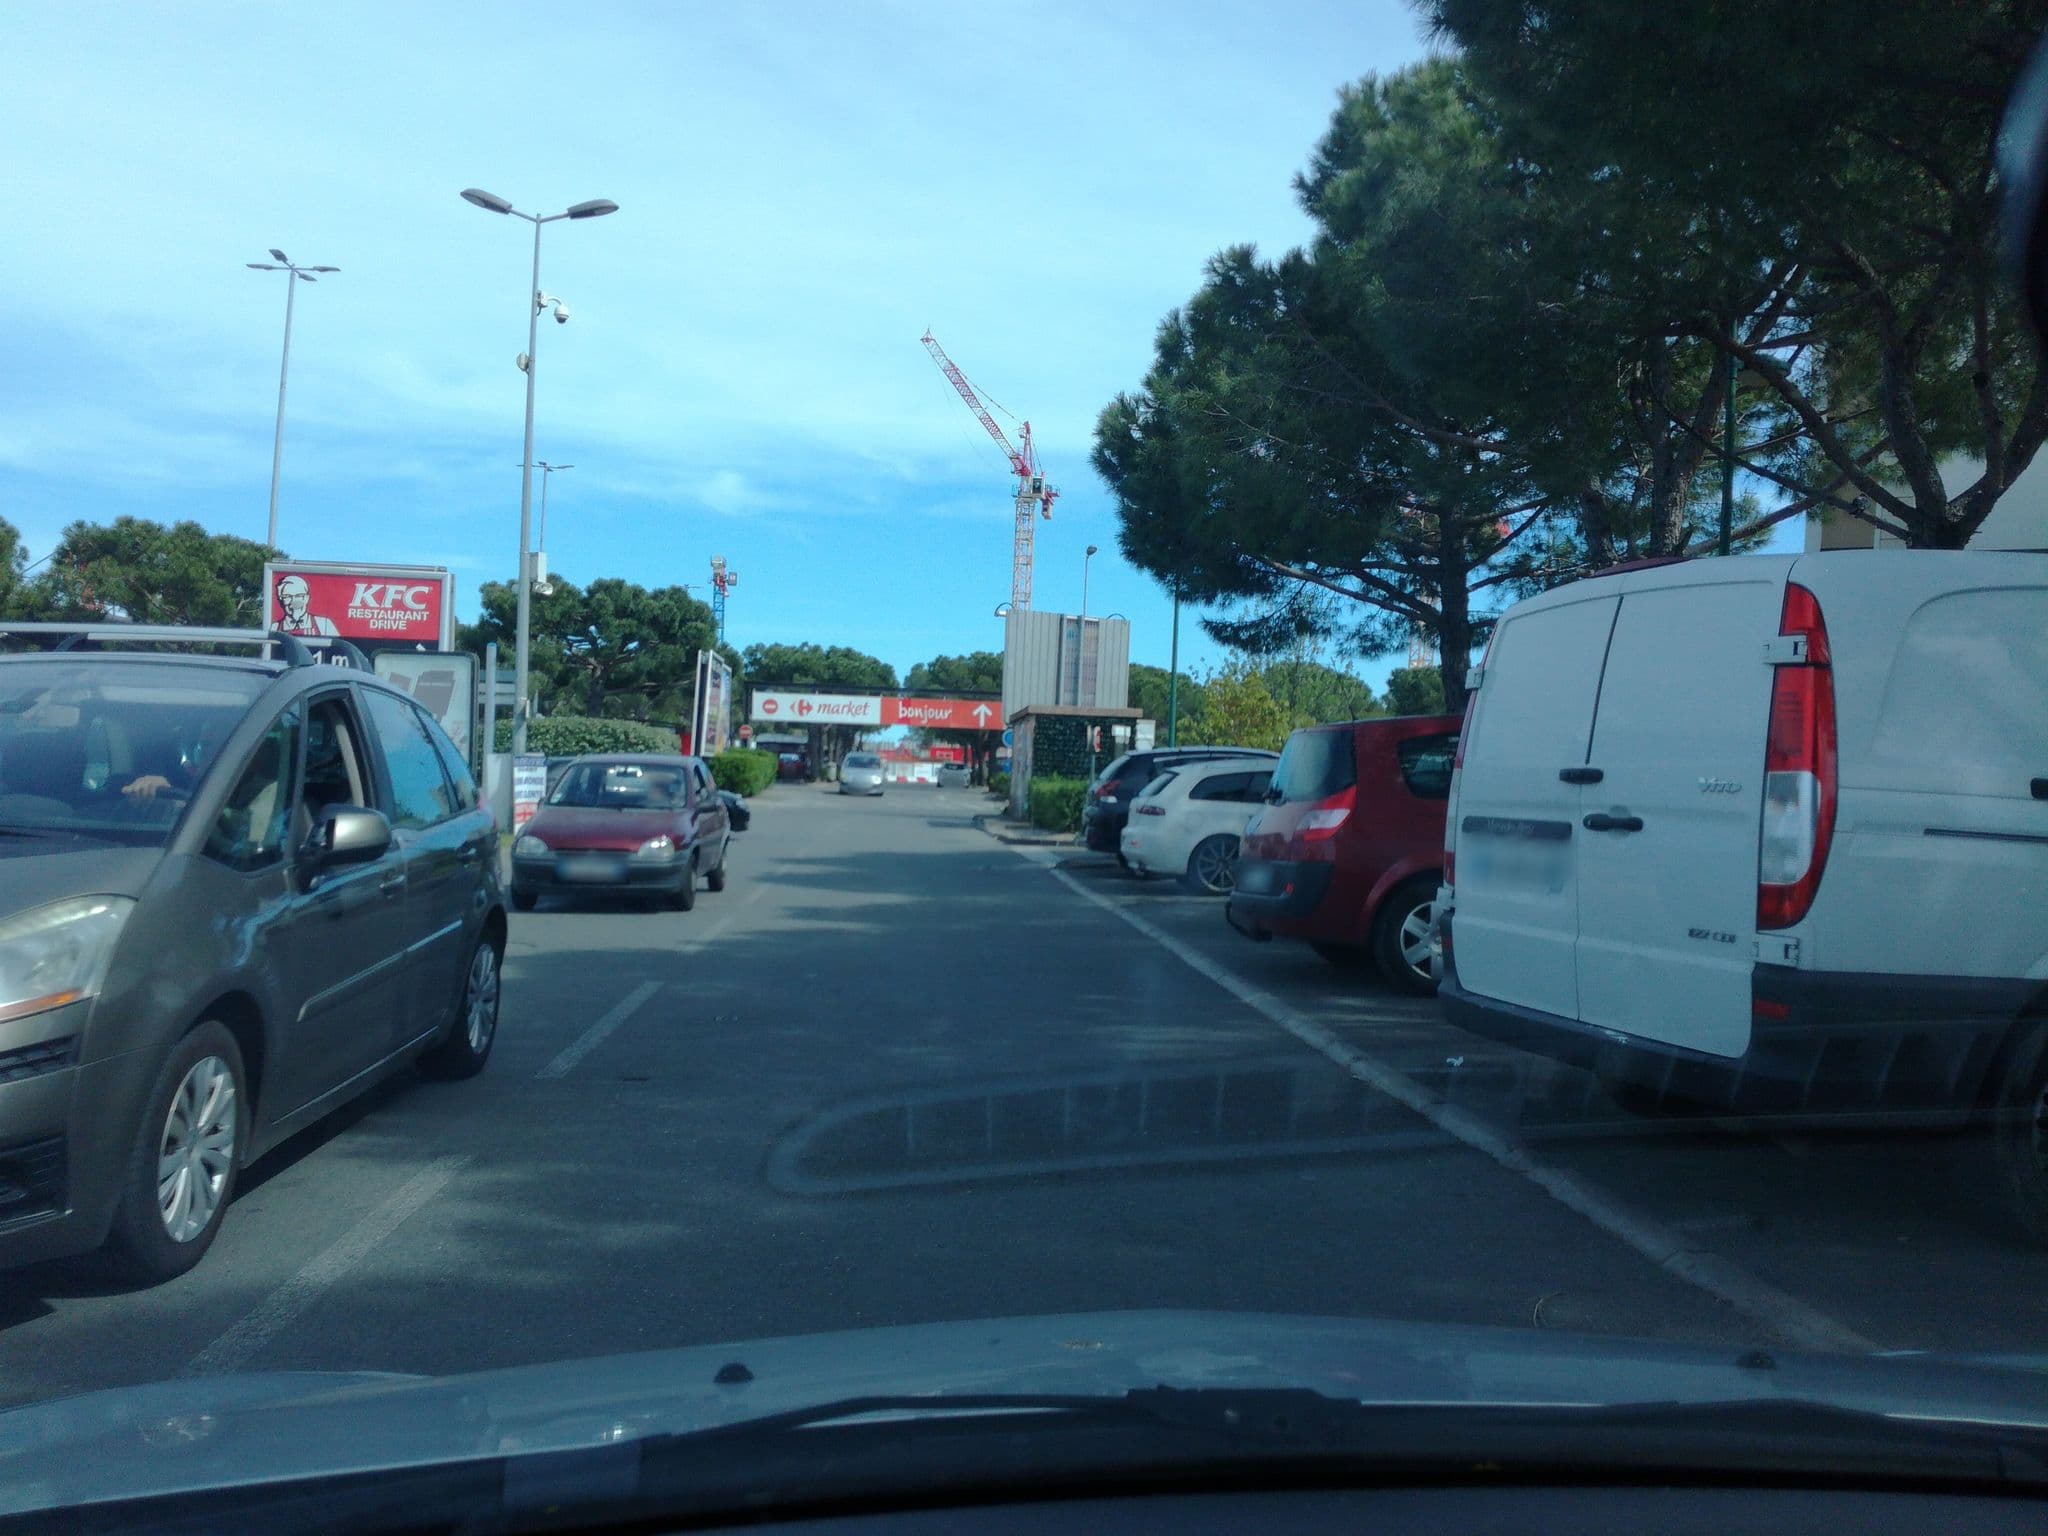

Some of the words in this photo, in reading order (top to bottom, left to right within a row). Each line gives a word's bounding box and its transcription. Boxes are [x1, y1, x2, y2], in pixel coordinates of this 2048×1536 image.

[349, 583, 430, 610] KFC
[348, 608, 430, 621] RESTAURANT
[369, 619, 408, 631] DRIVE
[816, 701, 871, 717] market
[898, 701, 953, 724] bonjour
